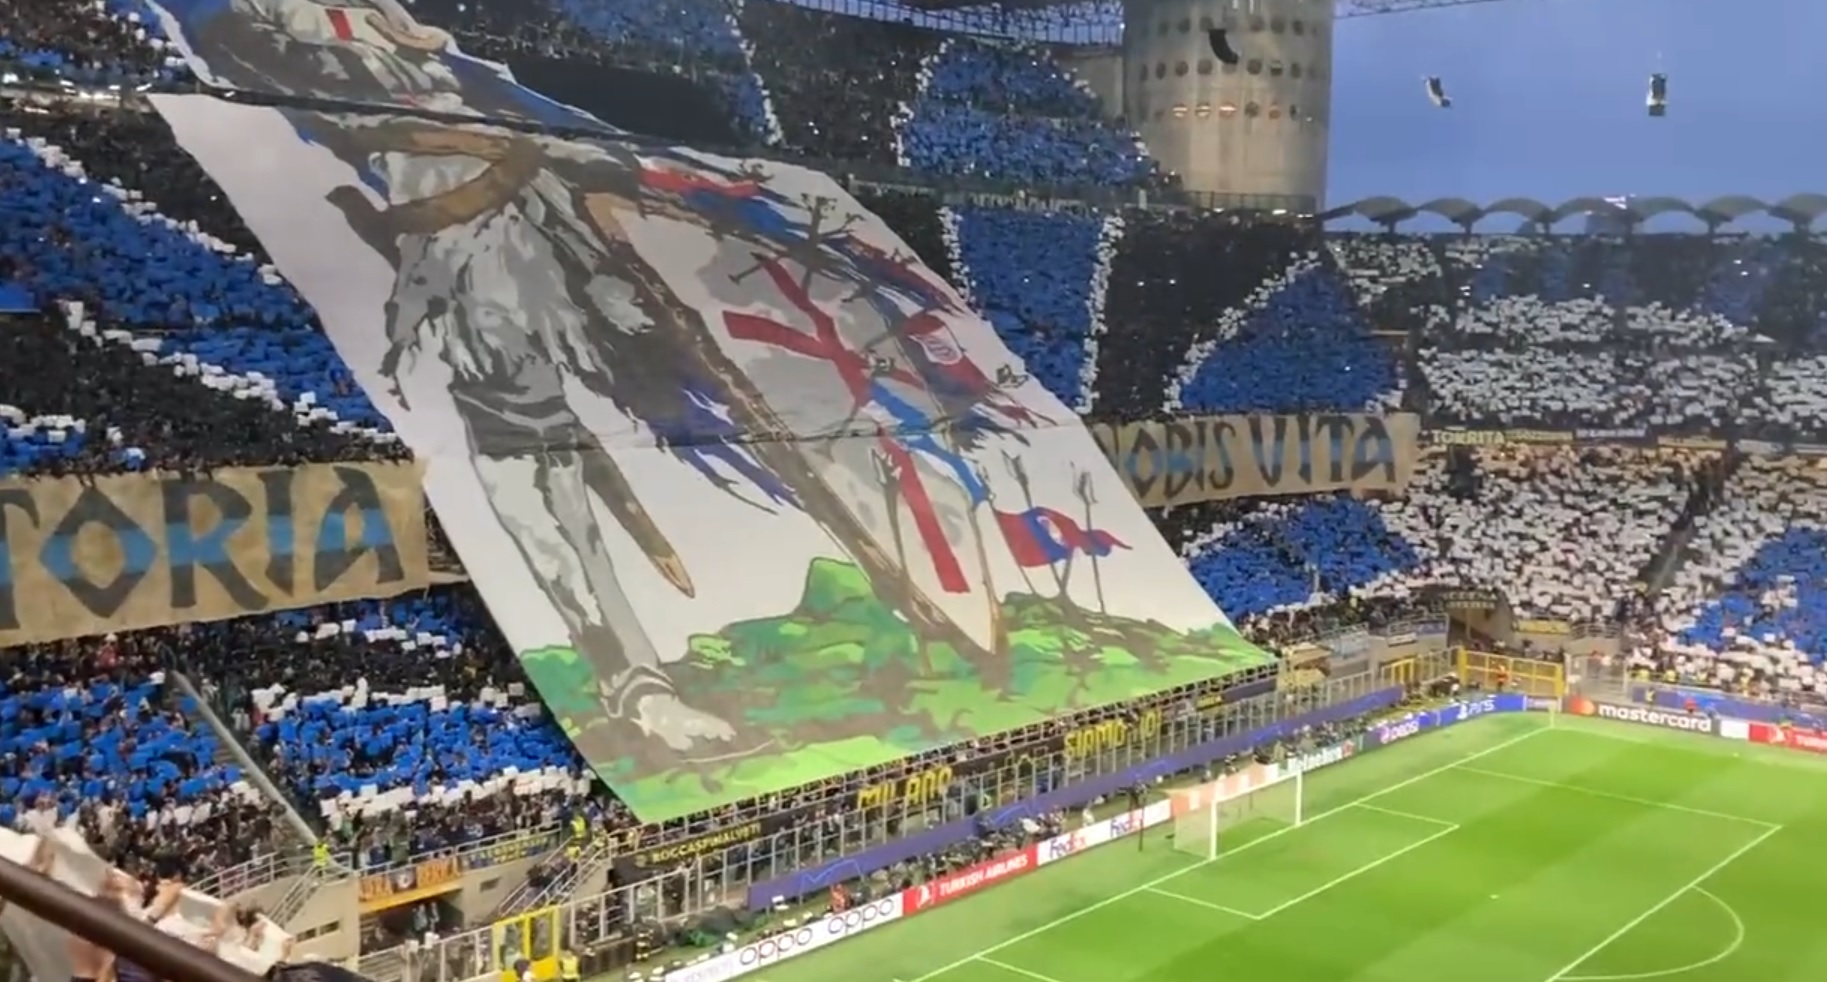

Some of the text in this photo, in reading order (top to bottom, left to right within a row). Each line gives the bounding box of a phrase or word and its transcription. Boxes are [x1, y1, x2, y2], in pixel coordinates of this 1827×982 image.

[1250, 414, 1397, 488] VITA
[1599, 703, 1712, 732] mastercard
[856, 766, 953, 810] MILANO
[940, 853, 1029, 897] TURKISH AIRLINES
[828, 898, 894, 936] oppo
[739, 927, 814, 968] oppo
